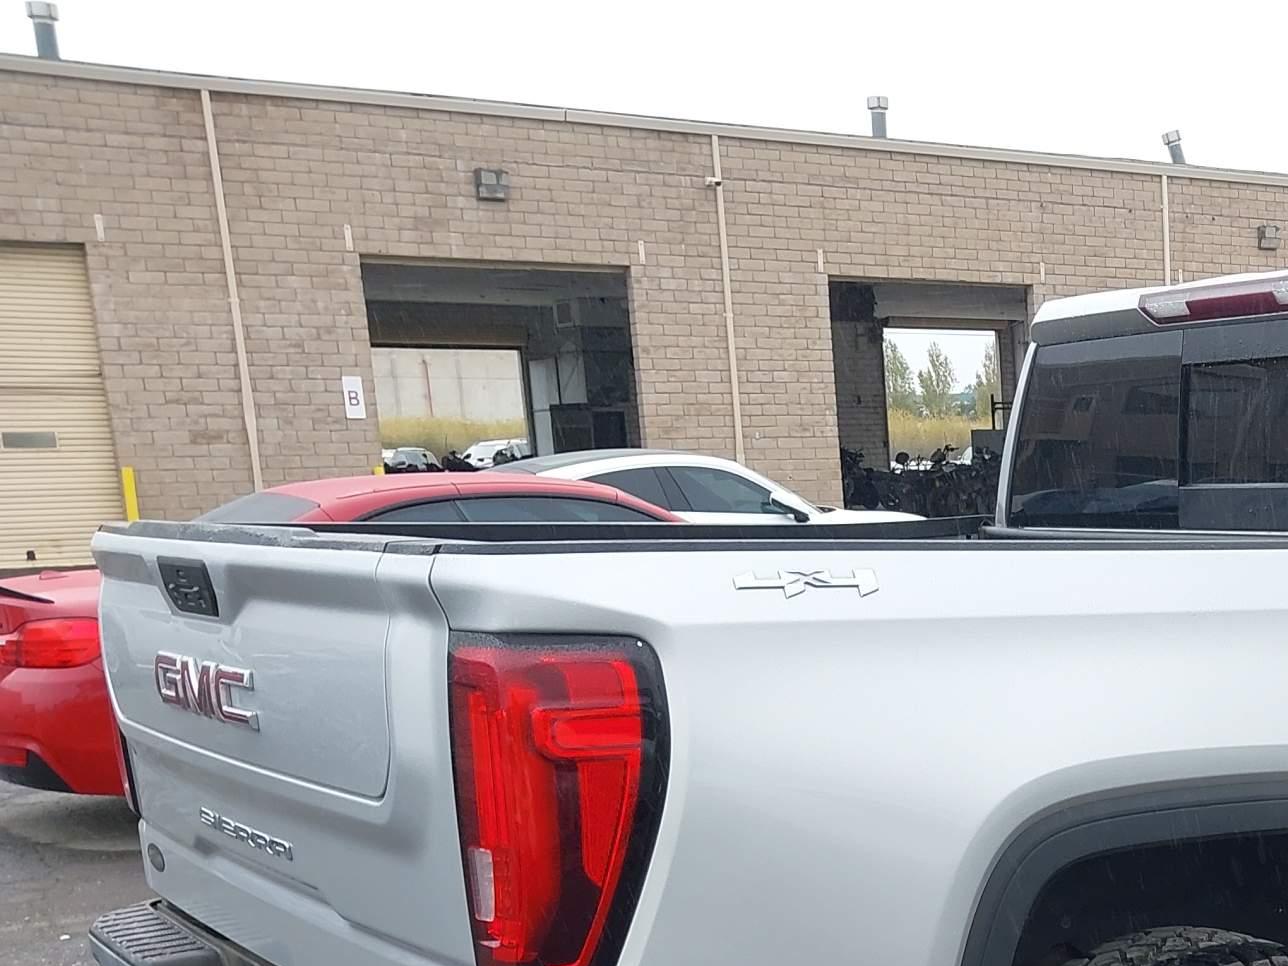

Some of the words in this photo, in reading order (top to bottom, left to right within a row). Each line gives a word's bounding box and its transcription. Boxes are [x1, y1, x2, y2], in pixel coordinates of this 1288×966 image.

[347, 390, 360, 406] B
[155, 650, 260, 732] GMC
[200, 807, 293, 861] SIERRA
